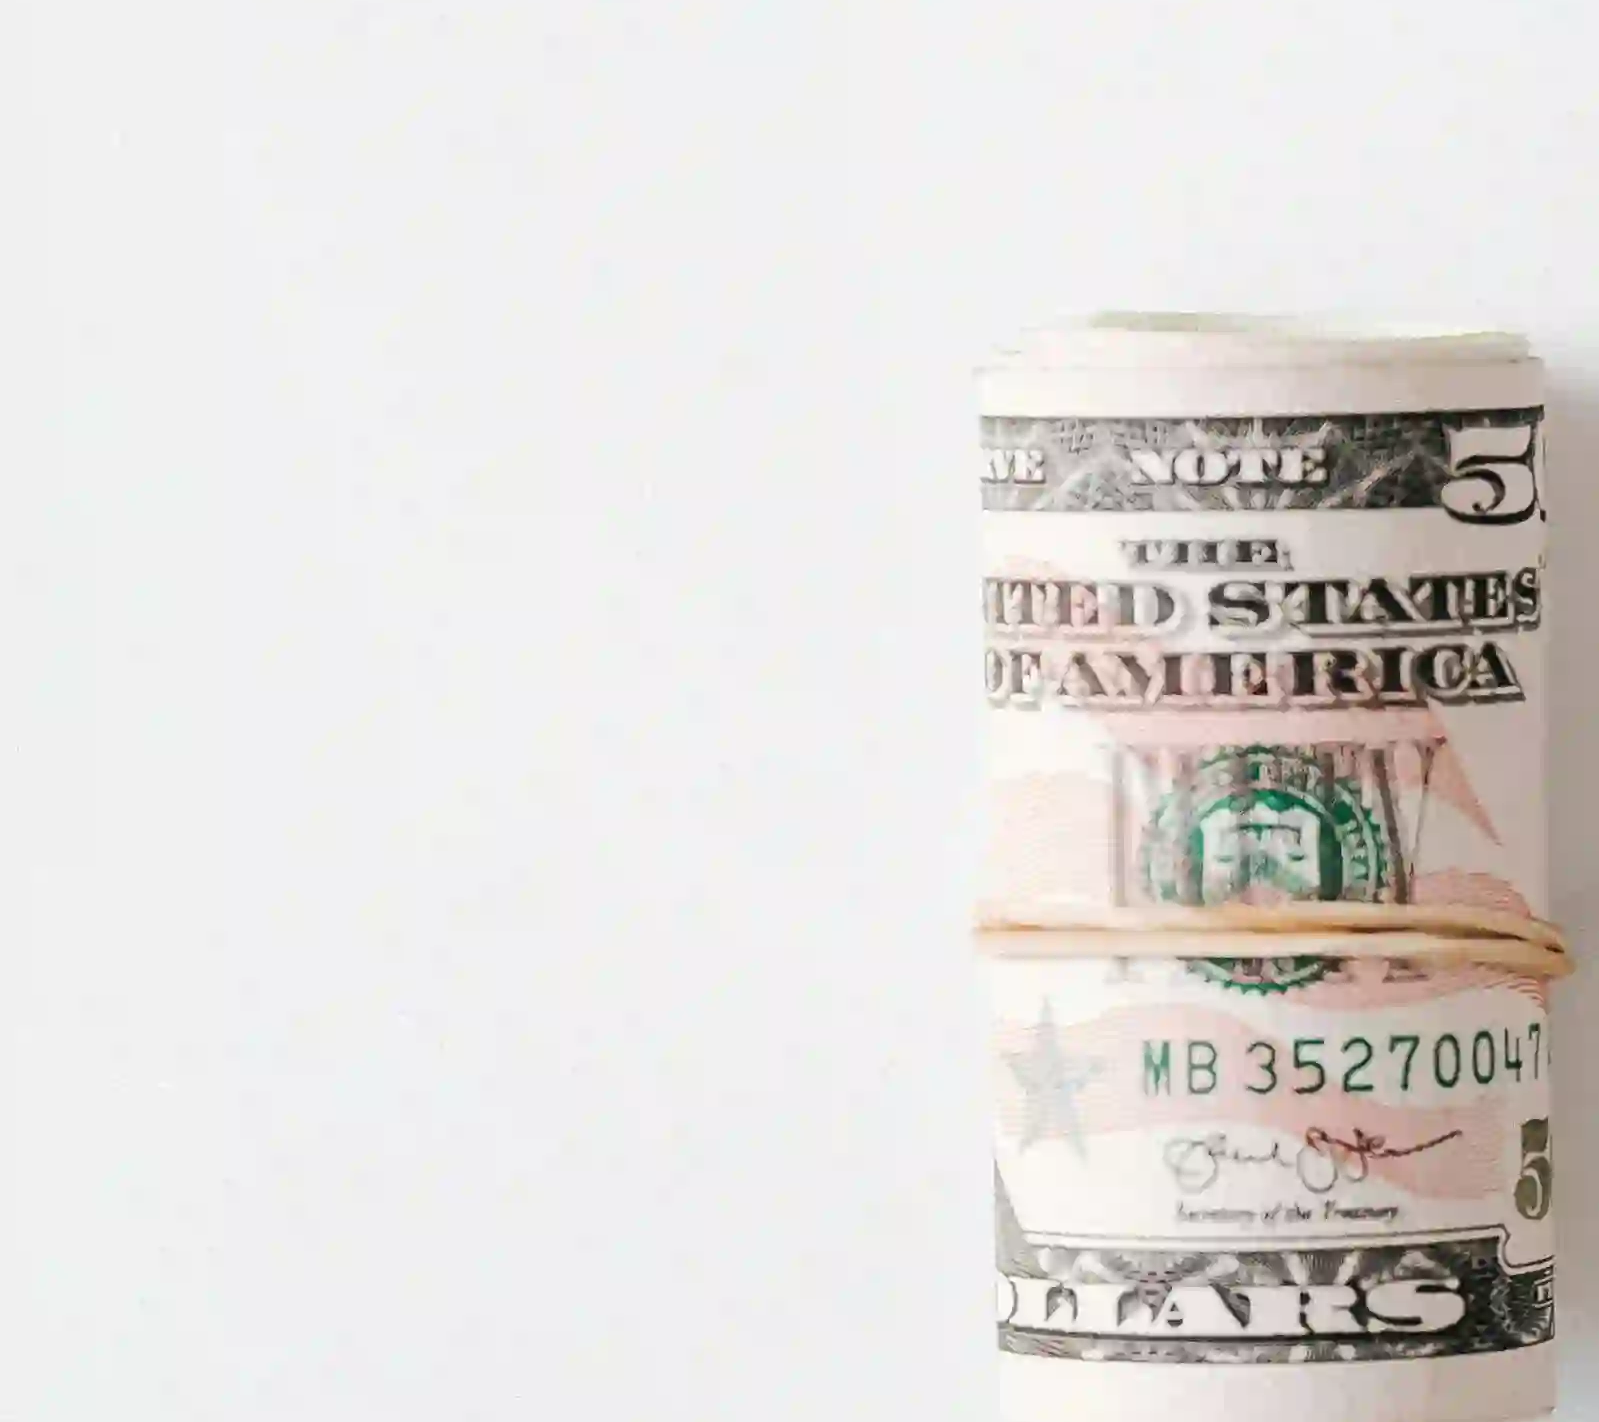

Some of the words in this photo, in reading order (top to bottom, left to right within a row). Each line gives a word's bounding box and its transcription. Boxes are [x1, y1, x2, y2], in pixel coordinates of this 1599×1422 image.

[1127, 446, 1327, 485] NOTE
[1120, 538, 1292, 570] THE
[1206, 566, 1541, 635] STATES
[1055, 641, 1527, 710] AMERICA
[1142, 1039, 1218, 1095] MB
[998, 1276, 1470, 1337] LLARS
